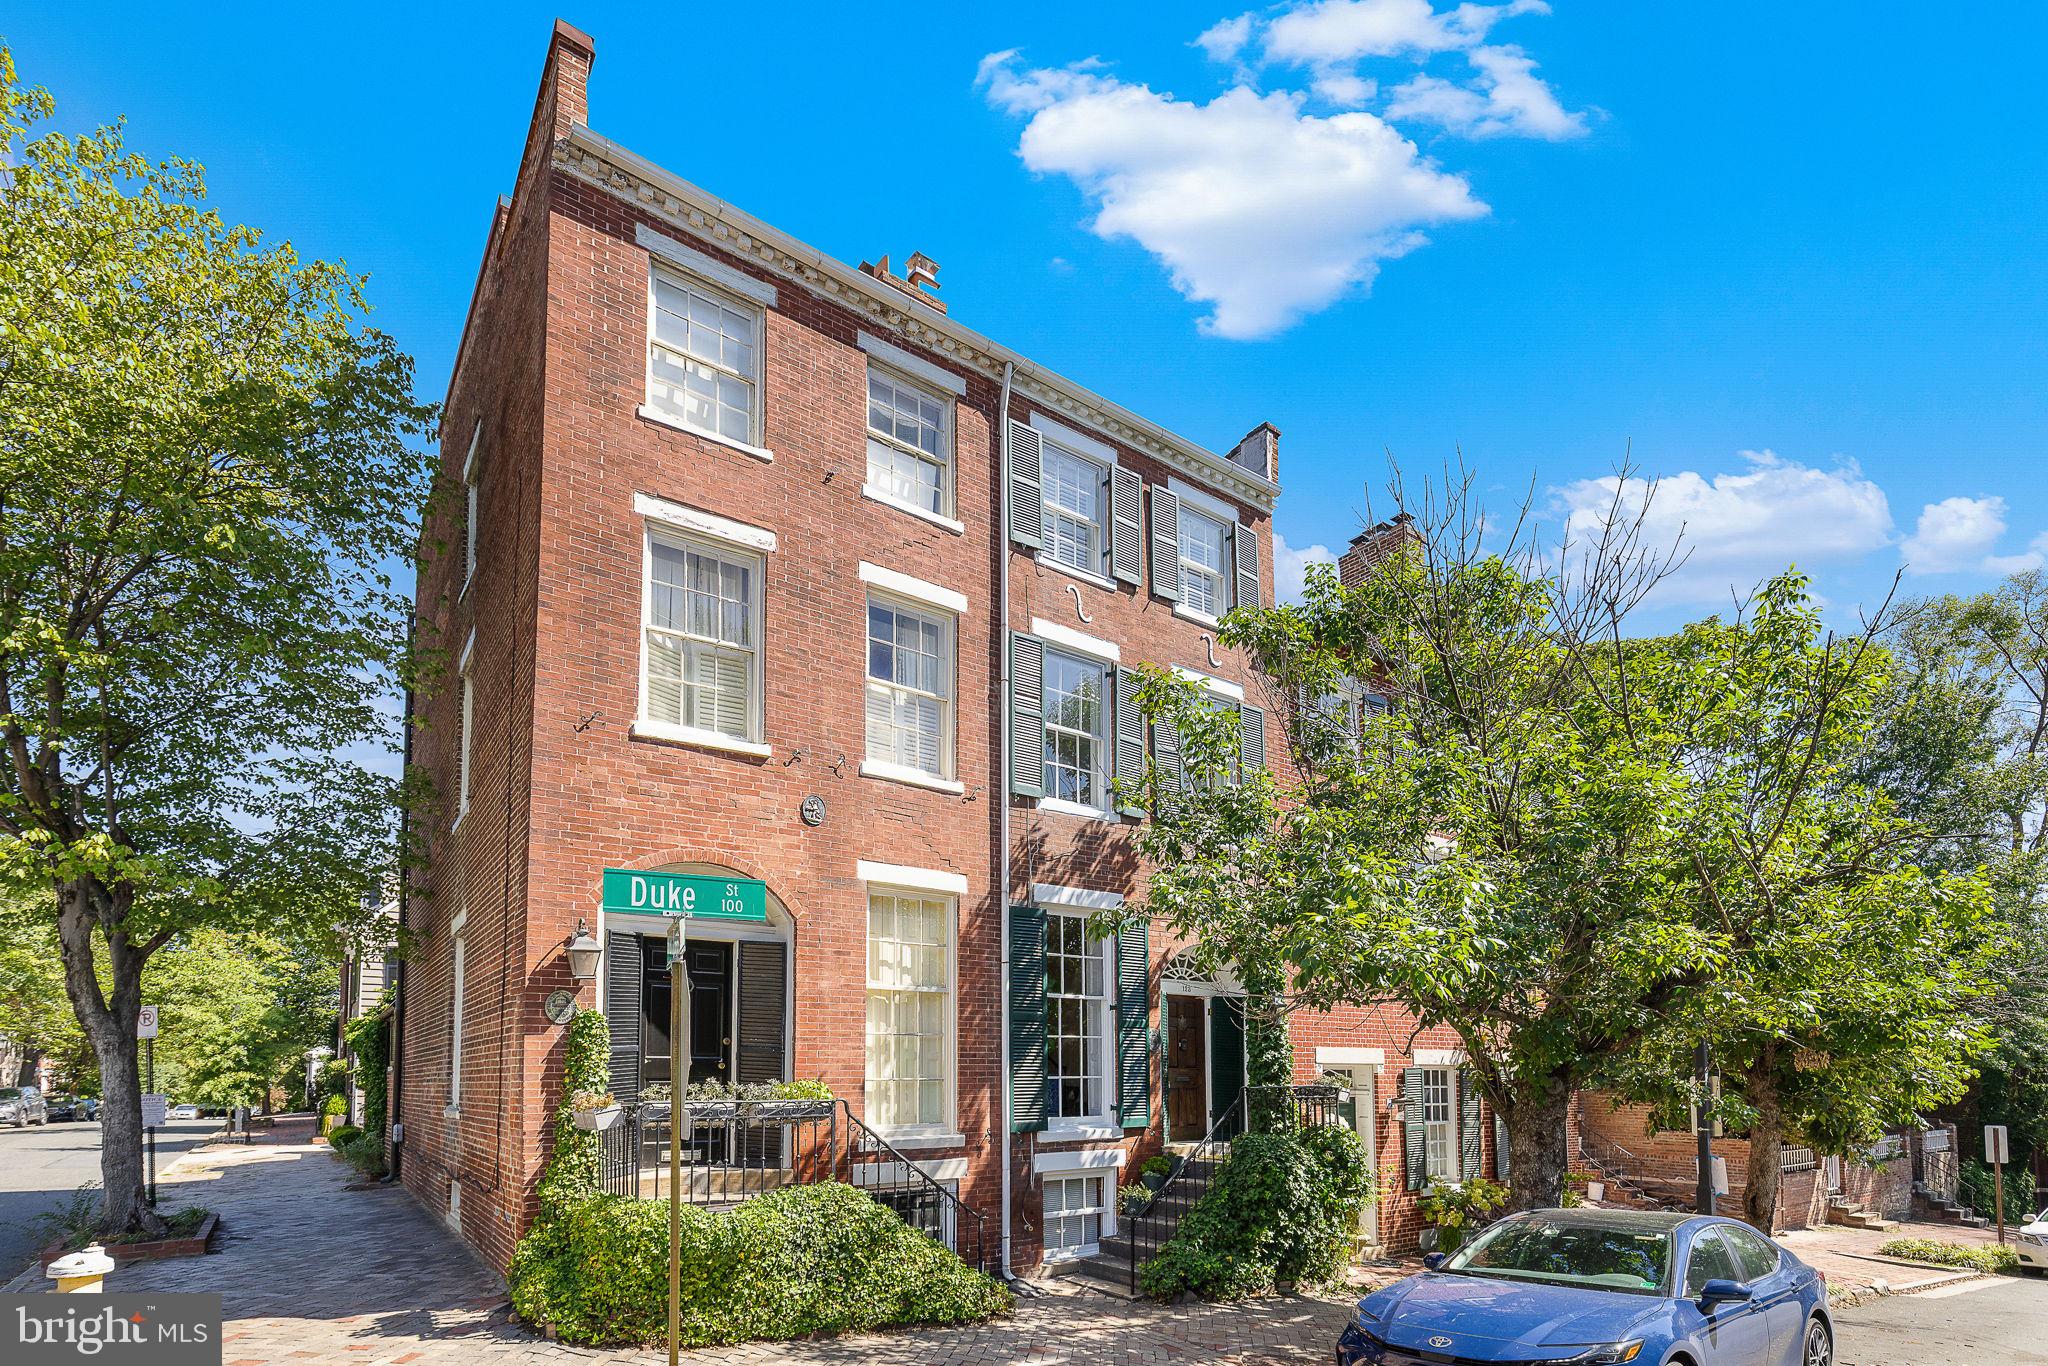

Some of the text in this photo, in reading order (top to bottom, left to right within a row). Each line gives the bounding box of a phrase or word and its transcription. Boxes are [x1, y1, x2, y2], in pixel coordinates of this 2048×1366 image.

[631, 876, 739, 910] Duke St
[721, 899, 744, 913] 100
